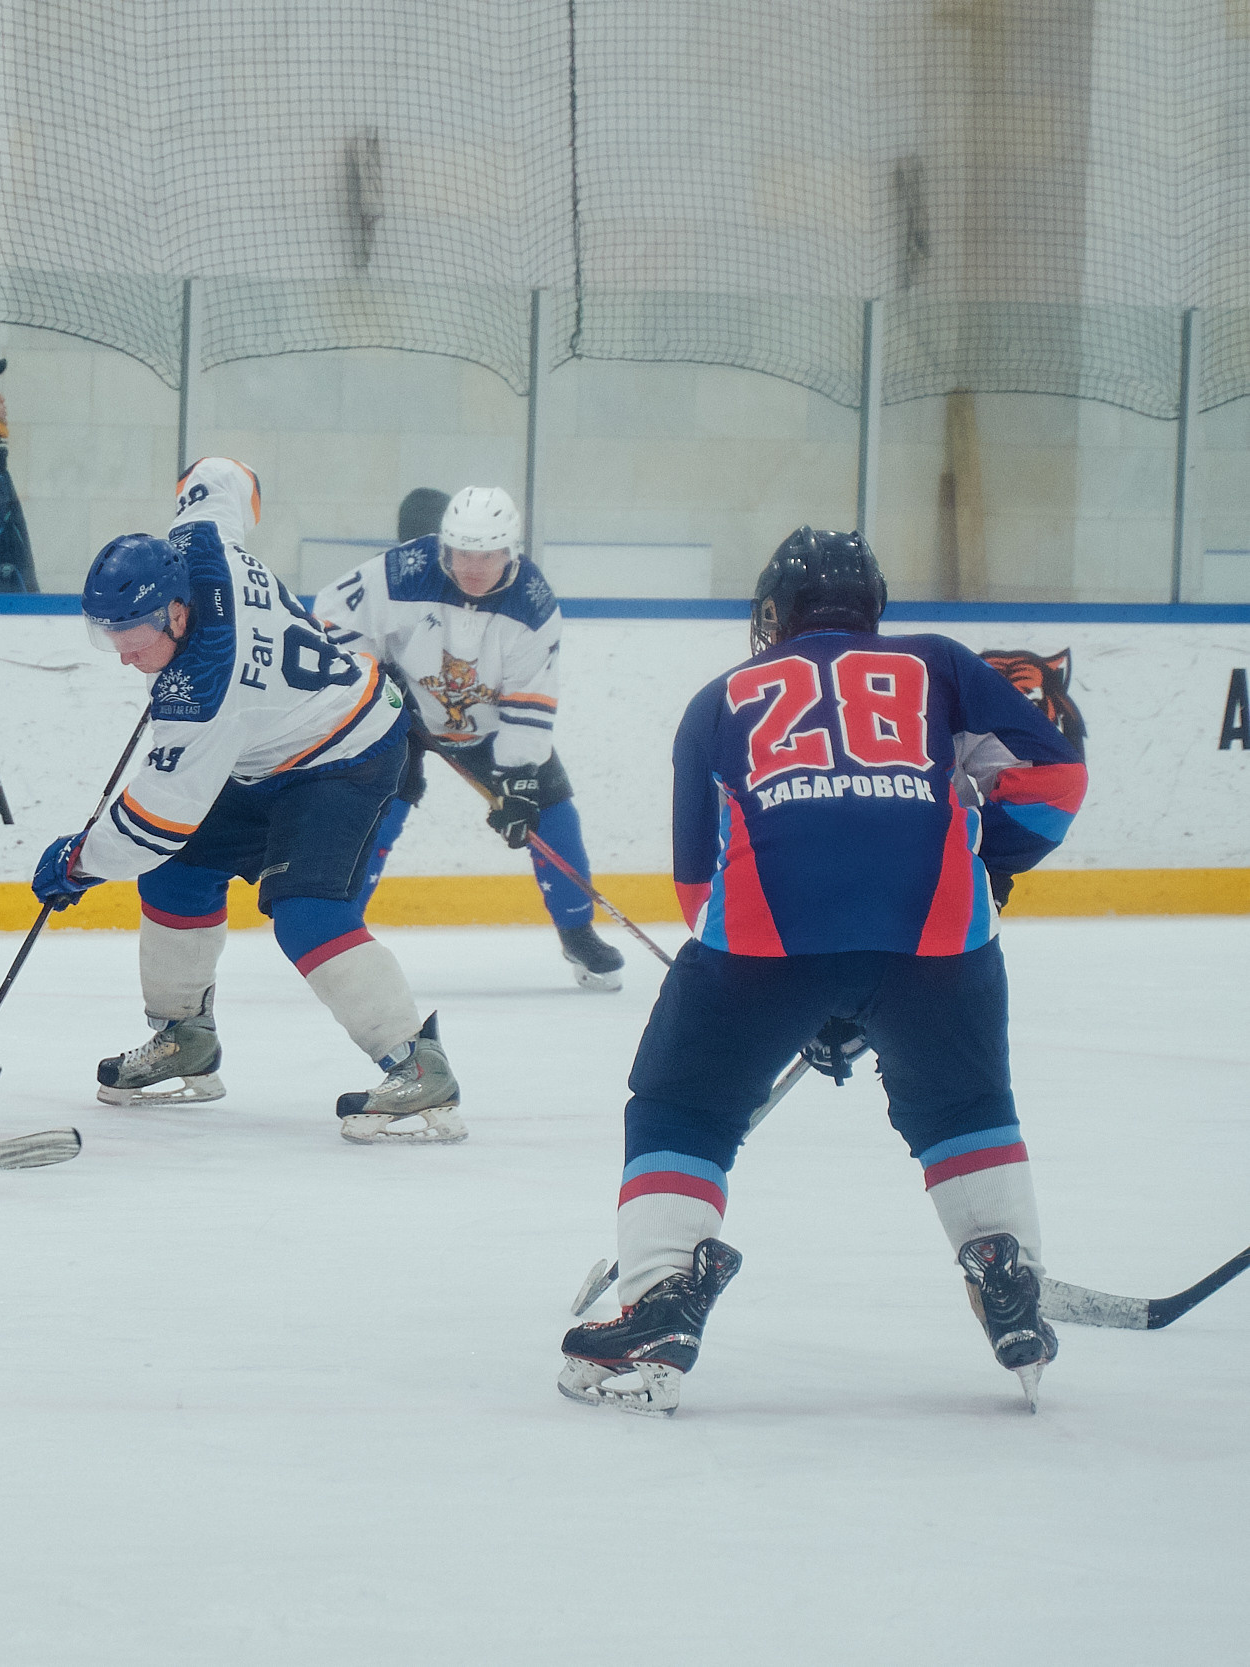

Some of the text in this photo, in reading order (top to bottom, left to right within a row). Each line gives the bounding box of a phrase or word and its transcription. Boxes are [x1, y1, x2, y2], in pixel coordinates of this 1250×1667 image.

[214, 588, 224, 616] LUTCH
[240, 627, 274, 691] Far
[725, 650, 936, 792] 28
[757, 774, 936, 811] ХАБАРОВСК
